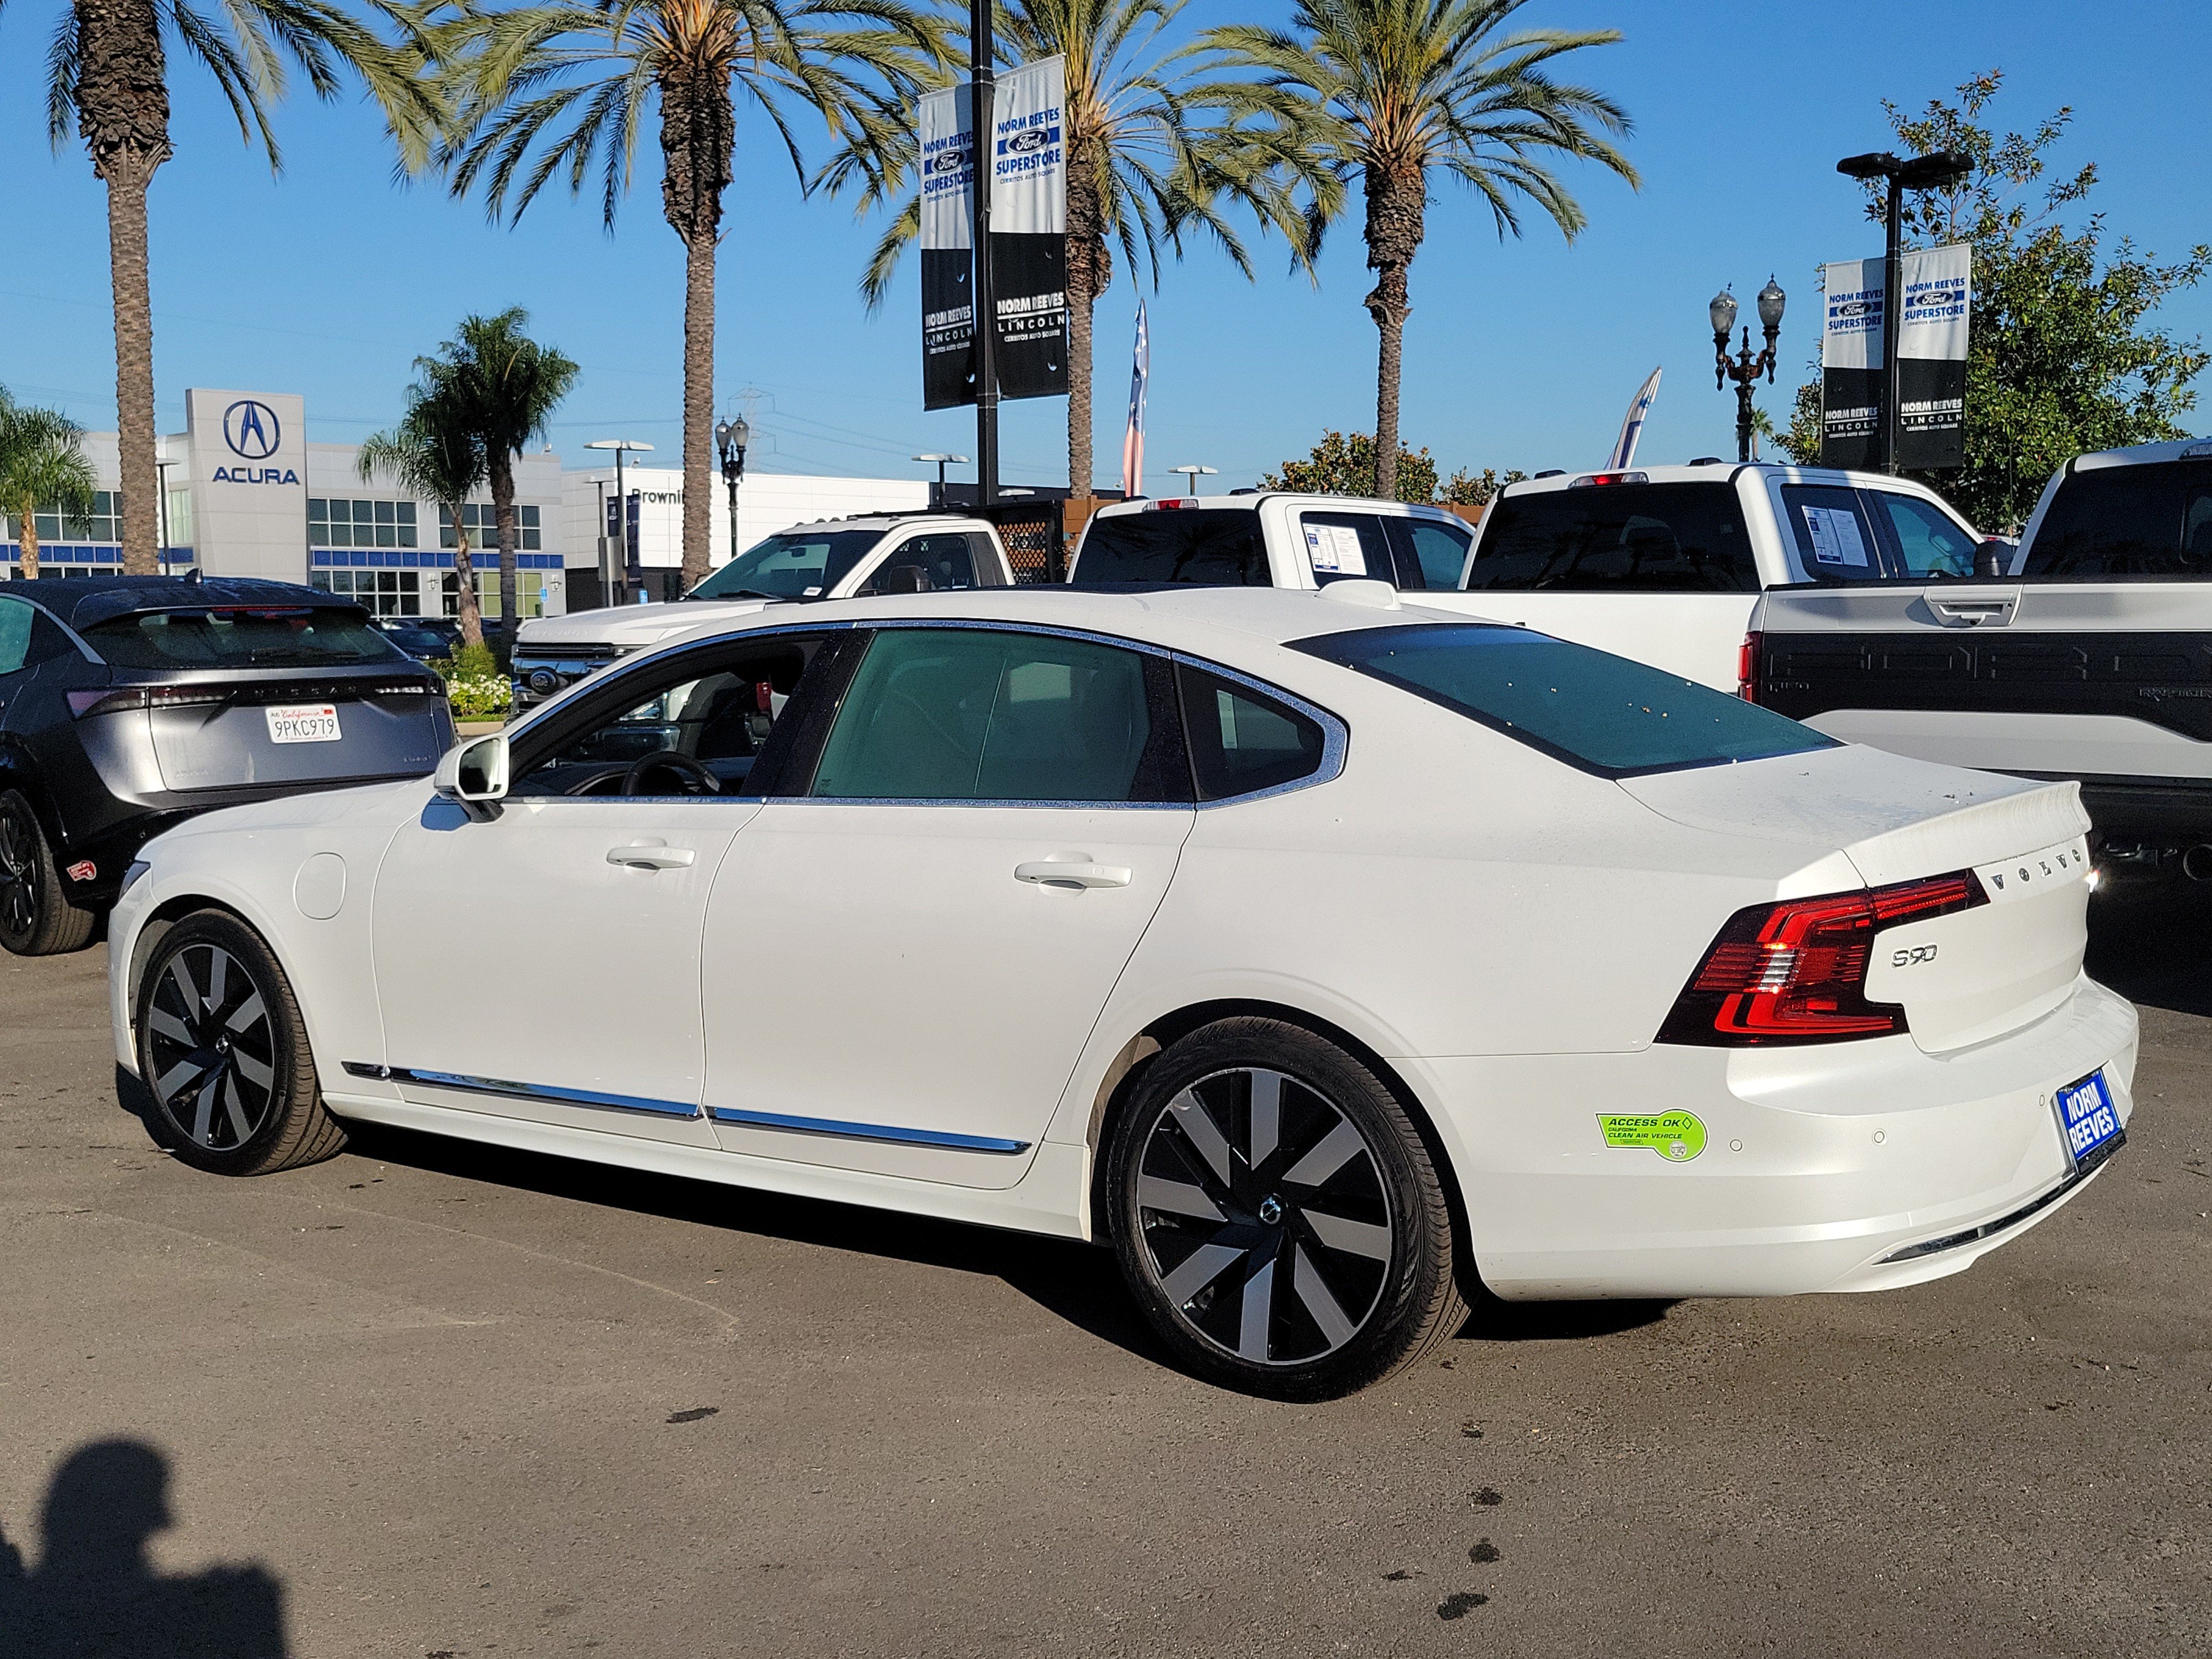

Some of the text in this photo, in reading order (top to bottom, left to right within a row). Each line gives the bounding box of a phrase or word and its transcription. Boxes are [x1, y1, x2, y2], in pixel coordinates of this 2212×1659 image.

[997, 107, 1059, 135] NORM REEVES
[924, 131, 973, 155] NORM REEVE
[1016, 133, 1042, 150] Ford
[938, 154, 960, 170] Ford
[996, 148, 1060, 176] SUPERSTORE
[924, 168, 974, 194] SUPERSTORE
[1906, 278, 1965, 294] NORM REEVES
[997, 292, 1064, 314] NORM REEVES
[1829, 289, 1883, 303] NORM REEVES
[1922, 293, 1946, 304] Ford
[925, 305, 971, 328] NORM REEVES
[1844, 304, 1865, 315] Ford
[1904, 304, 1965, 320] SUPERSTORE
[997, 314, 1065, 332] LINCOLN
[1829, 315, 1882, 330] SUPERSTORE
[926, 327, 972, 346] LINCOLN
[1825, 407, 1878, 420] NORM REEVES
[1901, 398, 1962, 413] NORM REEVES
[1824, 421, 1877, 432] LINCOLN
[1901, 413, 1962, 425] LINCOLN
[212, 466, 301, 486] ACURA
[632, 488, 684, 504] Browni
[255, 686, 357, 697] NISSAN
[275, 719, 334, 737] 9PKC979
[1990, 849, 2081, 890] VOLVO
[1891, 944, 1938, 968] S90
[2066, 1081, 2102, 1124] NORM
[2068, 1106, 2114, 1154] REEVES
